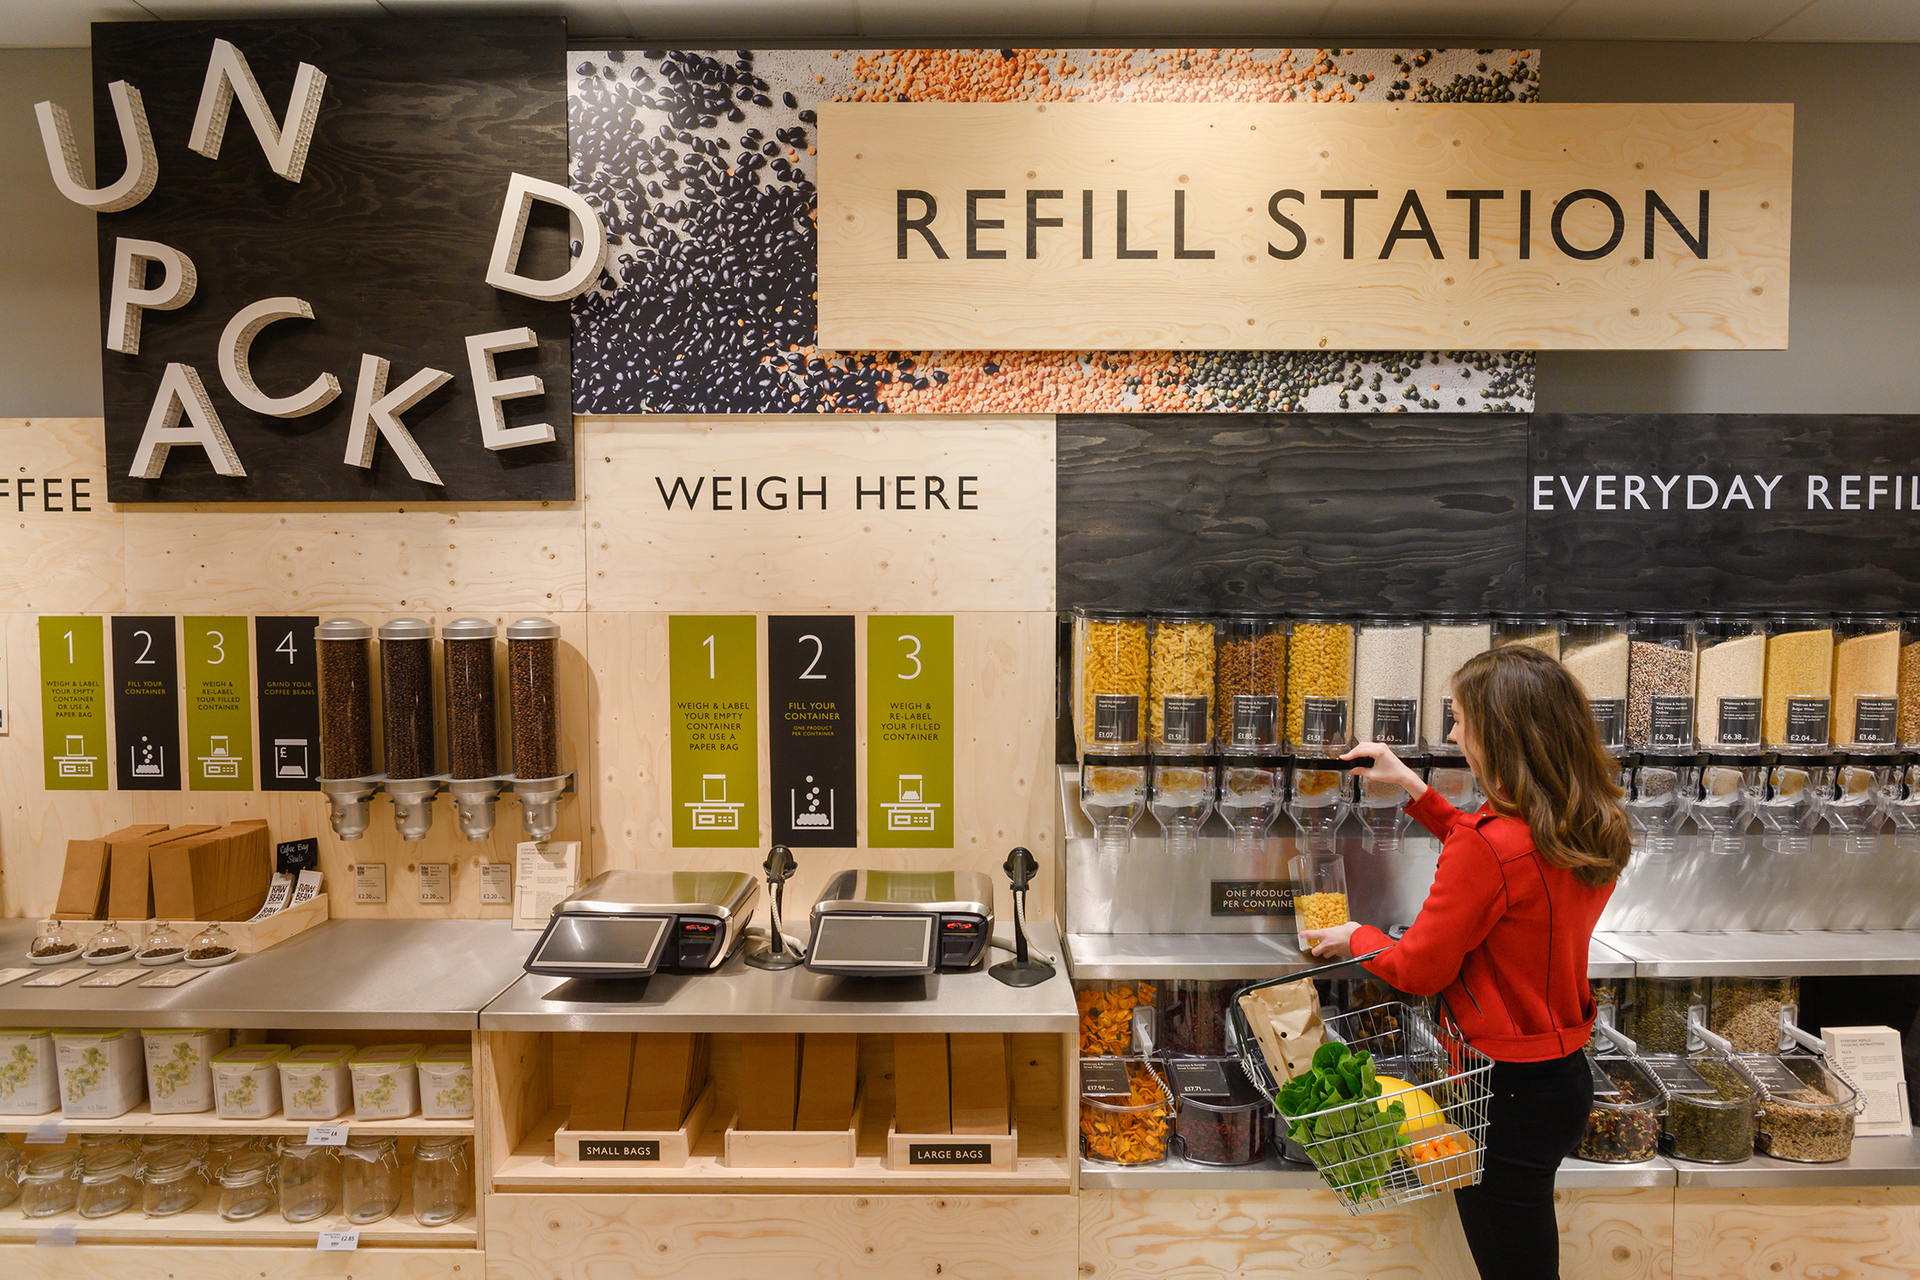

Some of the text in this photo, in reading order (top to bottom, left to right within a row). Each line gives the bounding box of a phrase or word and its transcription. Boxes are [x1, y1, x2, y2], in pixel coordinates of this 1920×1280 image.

[896, 188, 1710, 261] REFILL STATION
[655, 476, 978, 511] WEIGH HERE
[1533, 475, 1783, 510] EVERYDAY
[63, 630, 74, 664] 1
[133, 630, 155, 665] 2
[207, 630, 225, 665] 3
[275, 630, 297, 665] 4
[702, 635, 715, 679] 1
[799, 634, 827, 680] 2
[898, 635, 922, 680] 3
[678, 702, 710, 710] WEIGH
[788, 702, 836, 710] FILL YOUR
[890, 702, 922, 710] WEIGH
[785, 712, 840, 720] CONTAINER
[708, 733, 727, 741] USE
[883, 733, 939, 741] CONTAINER
[689, 743, 739, 751] PAPER BAG
[297, 843, 309, 854] Bag
[268, 893, 285, 901] BEAN
[1226, 890, 1246, 898] ONE
[1243, 900, 1293, 908] CONTAINE
[586, 1145, 651, 1157] SMALL BAGS
[917, 1148, 984, 1161] LARGE BAGS
